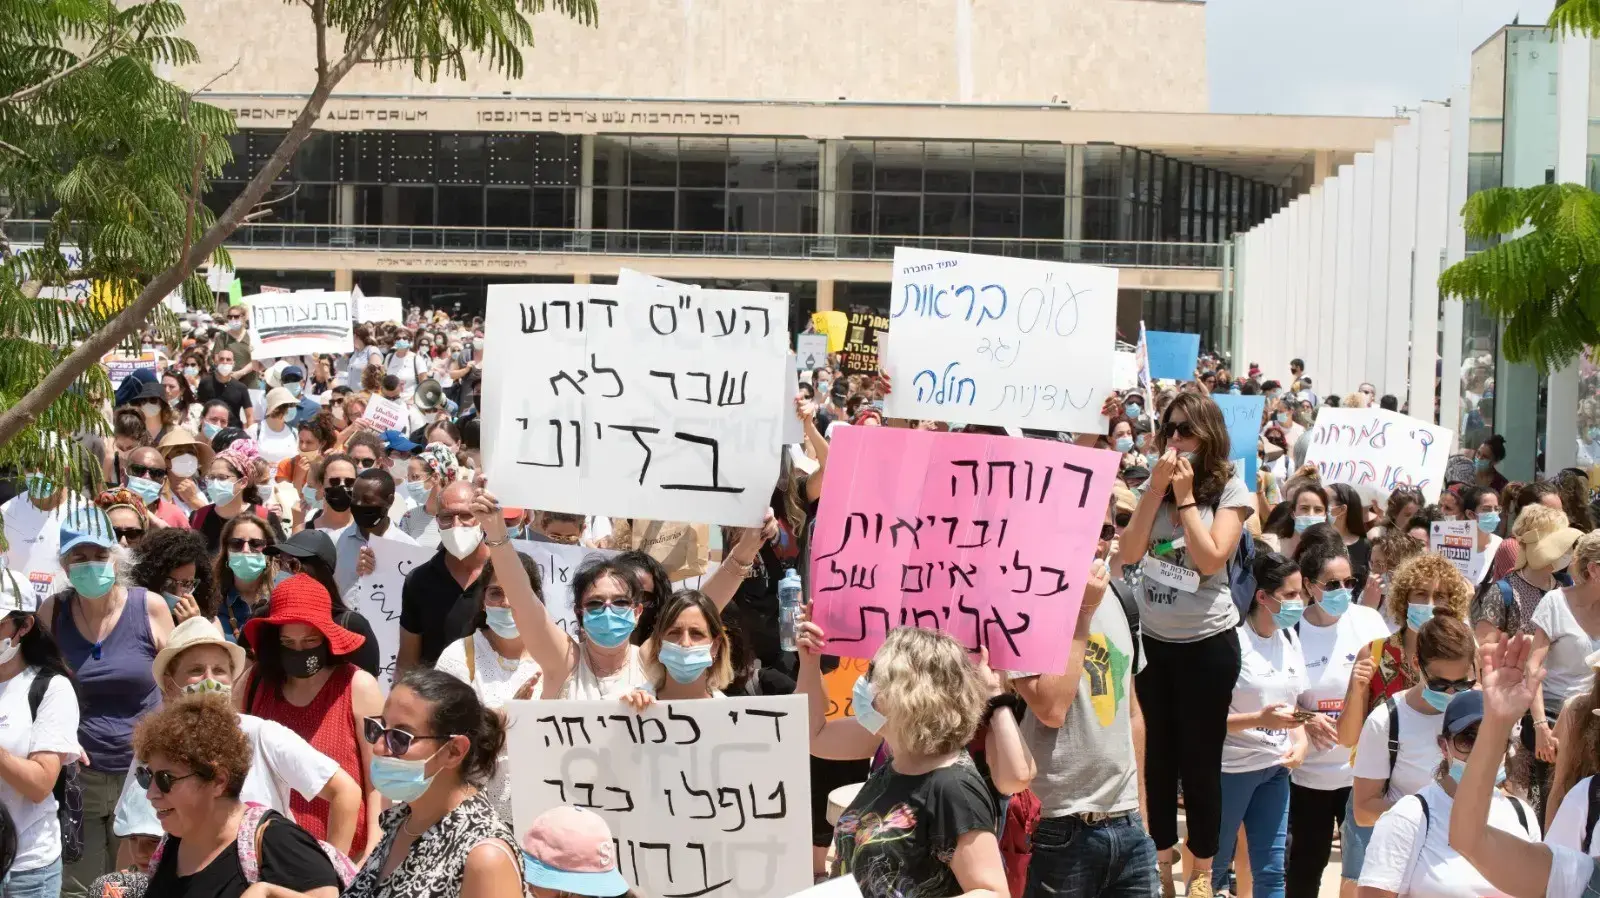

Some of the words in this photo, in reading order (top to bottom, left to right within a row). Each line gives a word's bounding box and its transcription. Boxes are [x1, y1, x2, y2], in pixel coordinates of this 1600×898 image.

[229, 108, 320, 121] BRONFM
[326, 109, 429, 121] AUDITORIUM
[476, 110, 543, 124] ברונפמן
[629, 111, 696, 124] התרבות
[700, 112, 741, 125] היכל
[902, 263, 934, 275] החברה
[935, 259, 958, 269] עתיד
[519, 298, 619, 334] דורש
[649, 295, 770, 338] העו"ס
[891, 283, 1008, 327] בריאות
[549, 352, 624, 398] לא
[649, 370, 749, 407] שכר
[912, 361, 977, 407] חולה
[1313, 418, 1393, 449] למריחה
[1408, 429, 1435, 467] די
[950, 459, 1094, 509] רווחה
[814, 511, 1009, 562] ובריאות
[818, 558, 879, 593] של
[900, 560, 978, 593] איום
[999, 549, 1070, 597] בלי
[536, 703, 702, 748] למריחה
[727, 708, 789, 743] די
[542, 779, 636, 813] כבר
[663, 770, 788, 833] טפלו
